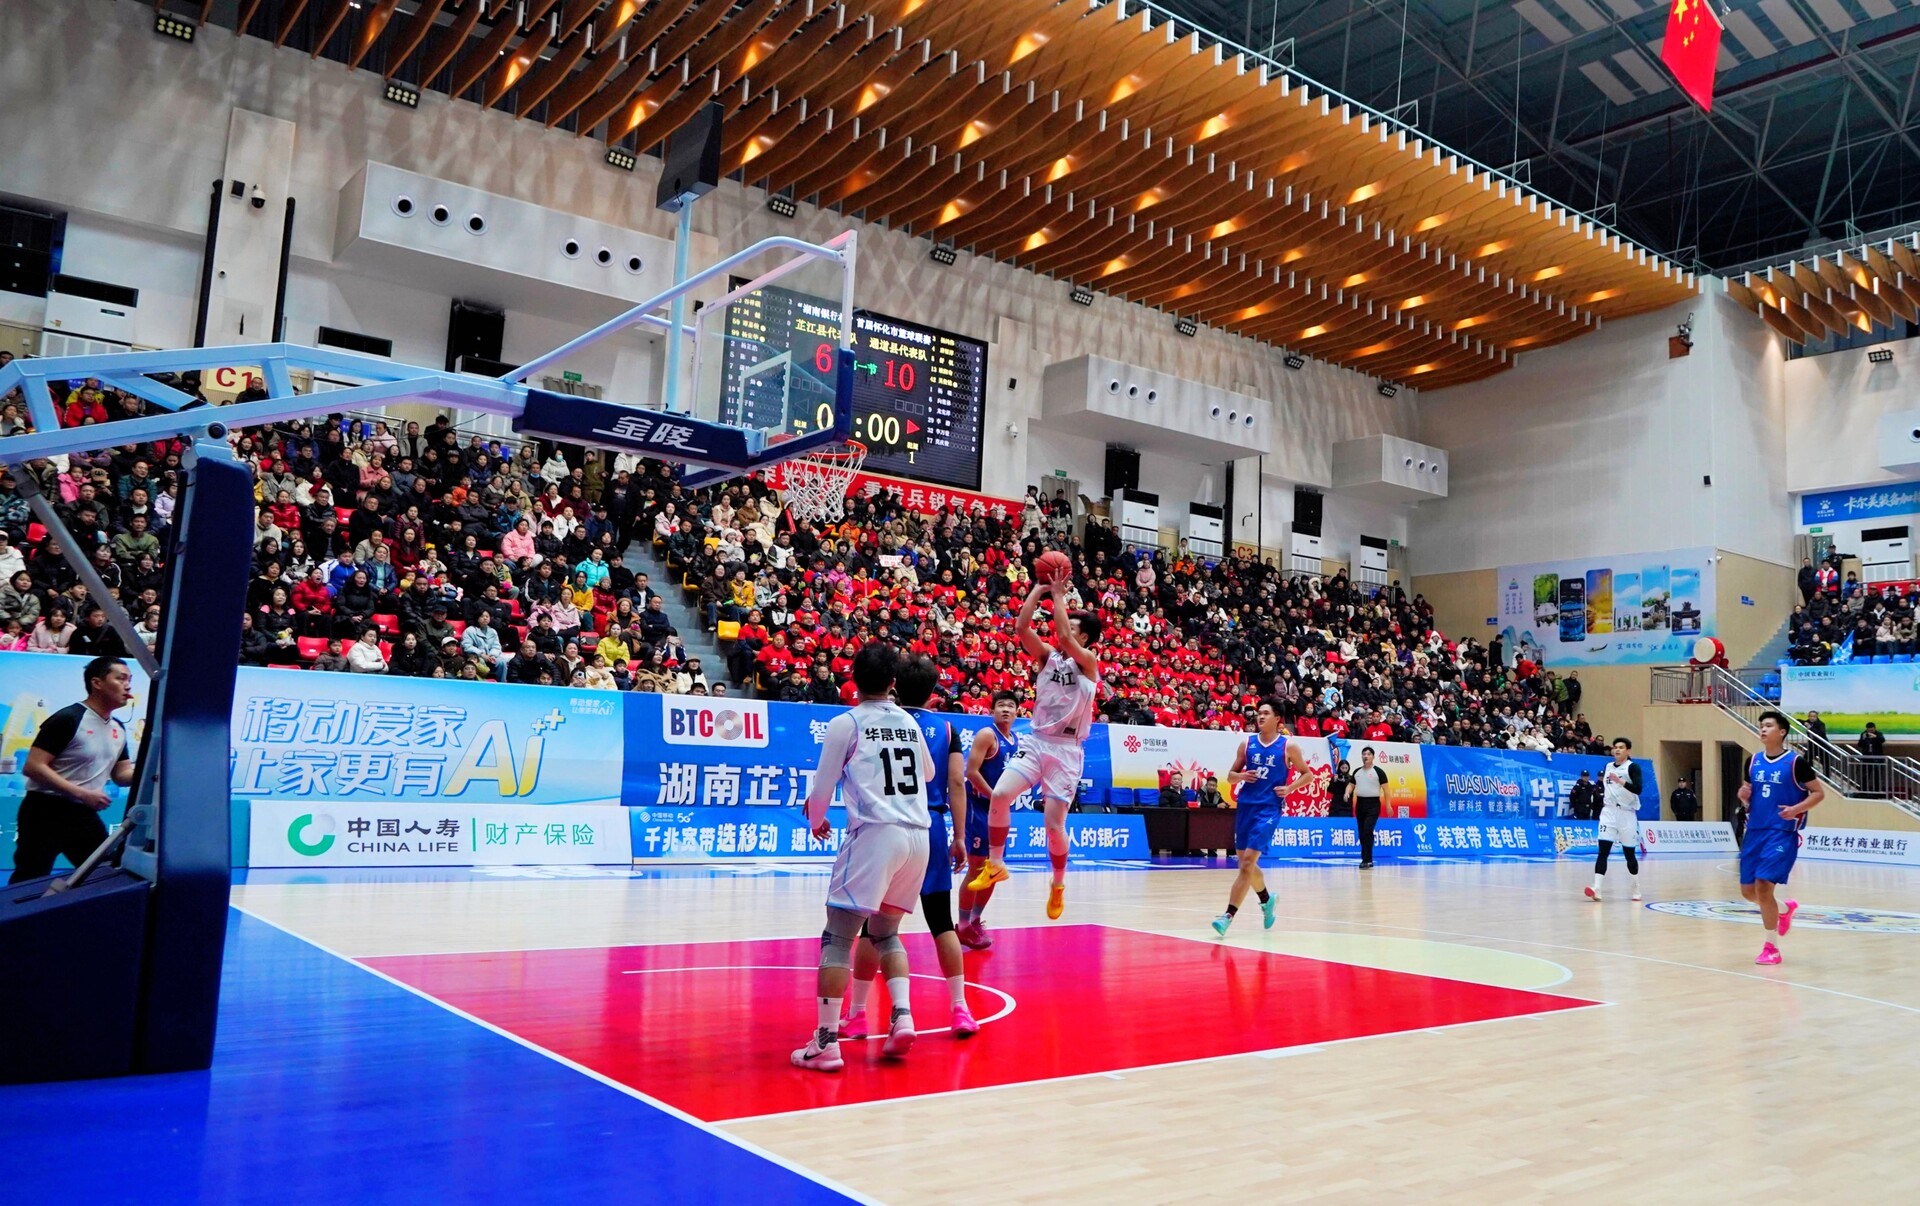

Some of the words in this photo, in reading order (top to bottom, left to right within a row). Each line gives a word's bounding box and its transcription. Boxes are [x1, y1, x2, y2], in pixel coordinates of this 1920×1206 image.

[856, 317, 931, 346] 首届怀化市篮球联赛
[869, 336, 928, 362] 通道县代表队
[216, 367, 253, 390] C1
[815, 343, 833, 373] 6
[884, 359, 915, 391] 10
[592, 416, 708, 453] 金陵
[908, 451, 915, 464] 1
[1237, 546, 1254, 561] C3
[241, 696, 468, 748] 移动爱家
[670, 708, 764, 741] BTCOIL
[879, 747, 919, 796] 13
[1755, 770, 1782, 784] 通道
[1446, 774, 1520, 796] HUASUNtech
[1761, 784, 1771, 798] 5
[1449, 800, 1483, 812] 创新科技
[1488, 801, 1520, 813] 智造未来
[347, 817, 461, 838] 中国人寿
[485, 822, 595, 846] 财产保险
[644, 822, 779, 853] 千兆宽带选移动
[973, 836, 981, 849] 3
[1271, 828, 1323, 847] 湖南银行
[1436, 825, 1482, 849] 装宽带
[1486, 826, 1529, 849] 选电信
[1806, 834, 1908, 851] 怀化农村商业银行
[347, 842, 411, 852] CHINA
[418, 842, 459, 852] LIFE
